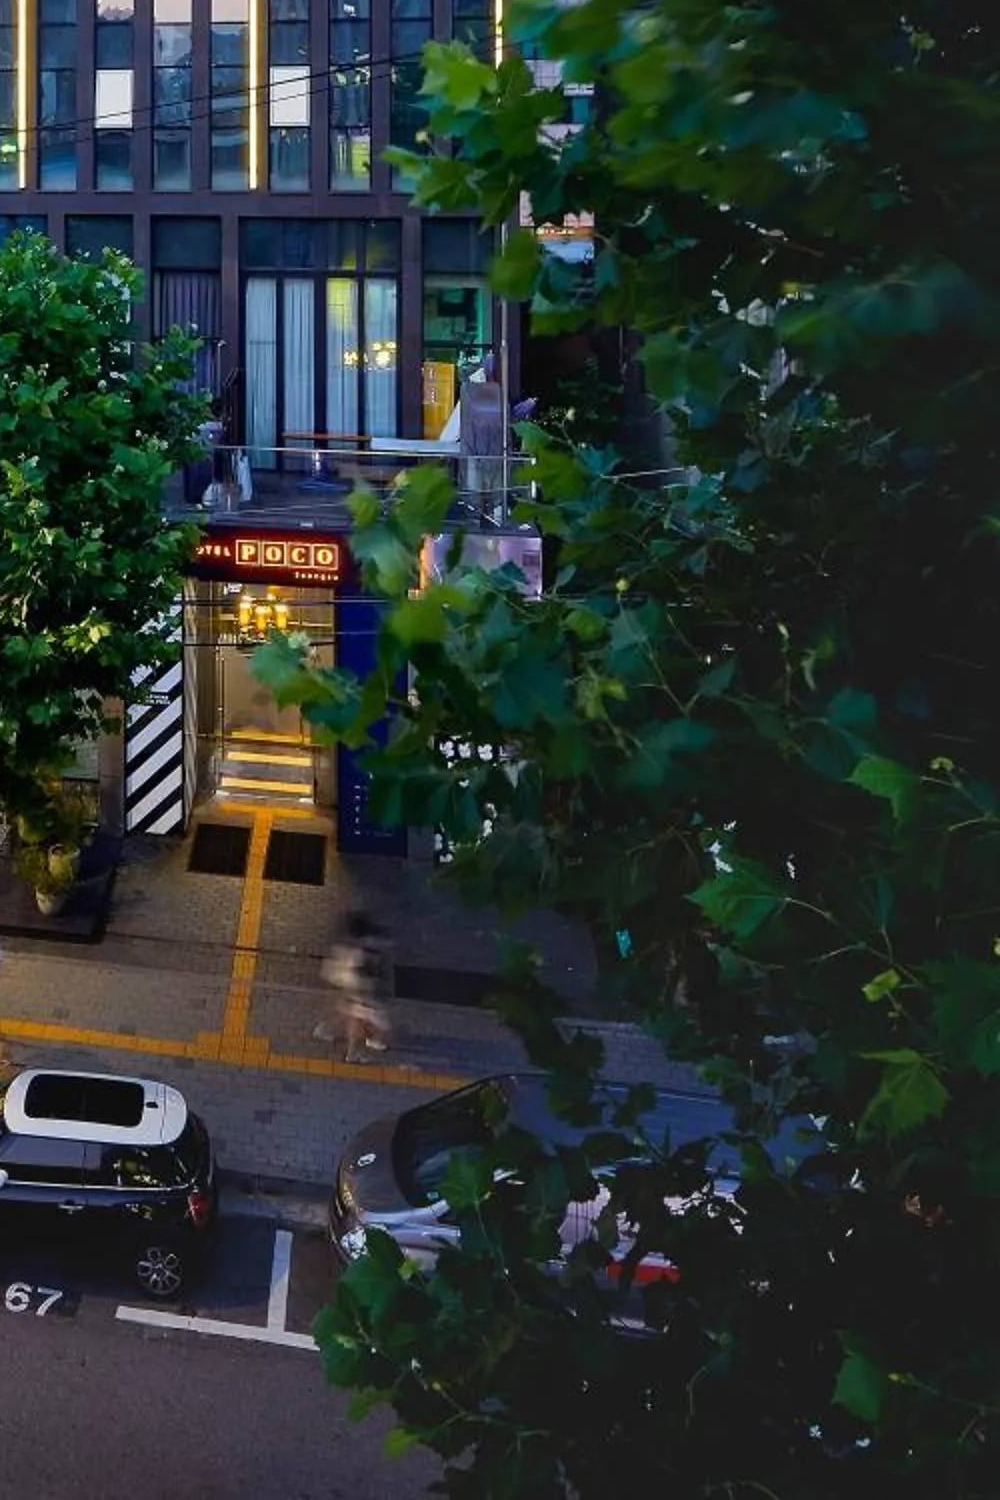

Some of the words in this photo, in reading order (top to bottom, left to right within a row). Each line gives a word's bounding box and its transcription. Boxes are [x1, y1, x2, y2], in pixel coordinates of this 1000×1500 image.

[195, 544, 232, 557] OTEL
[240, 543, 335, 565] POCO
[5, 1281, 64, 1317] 67
